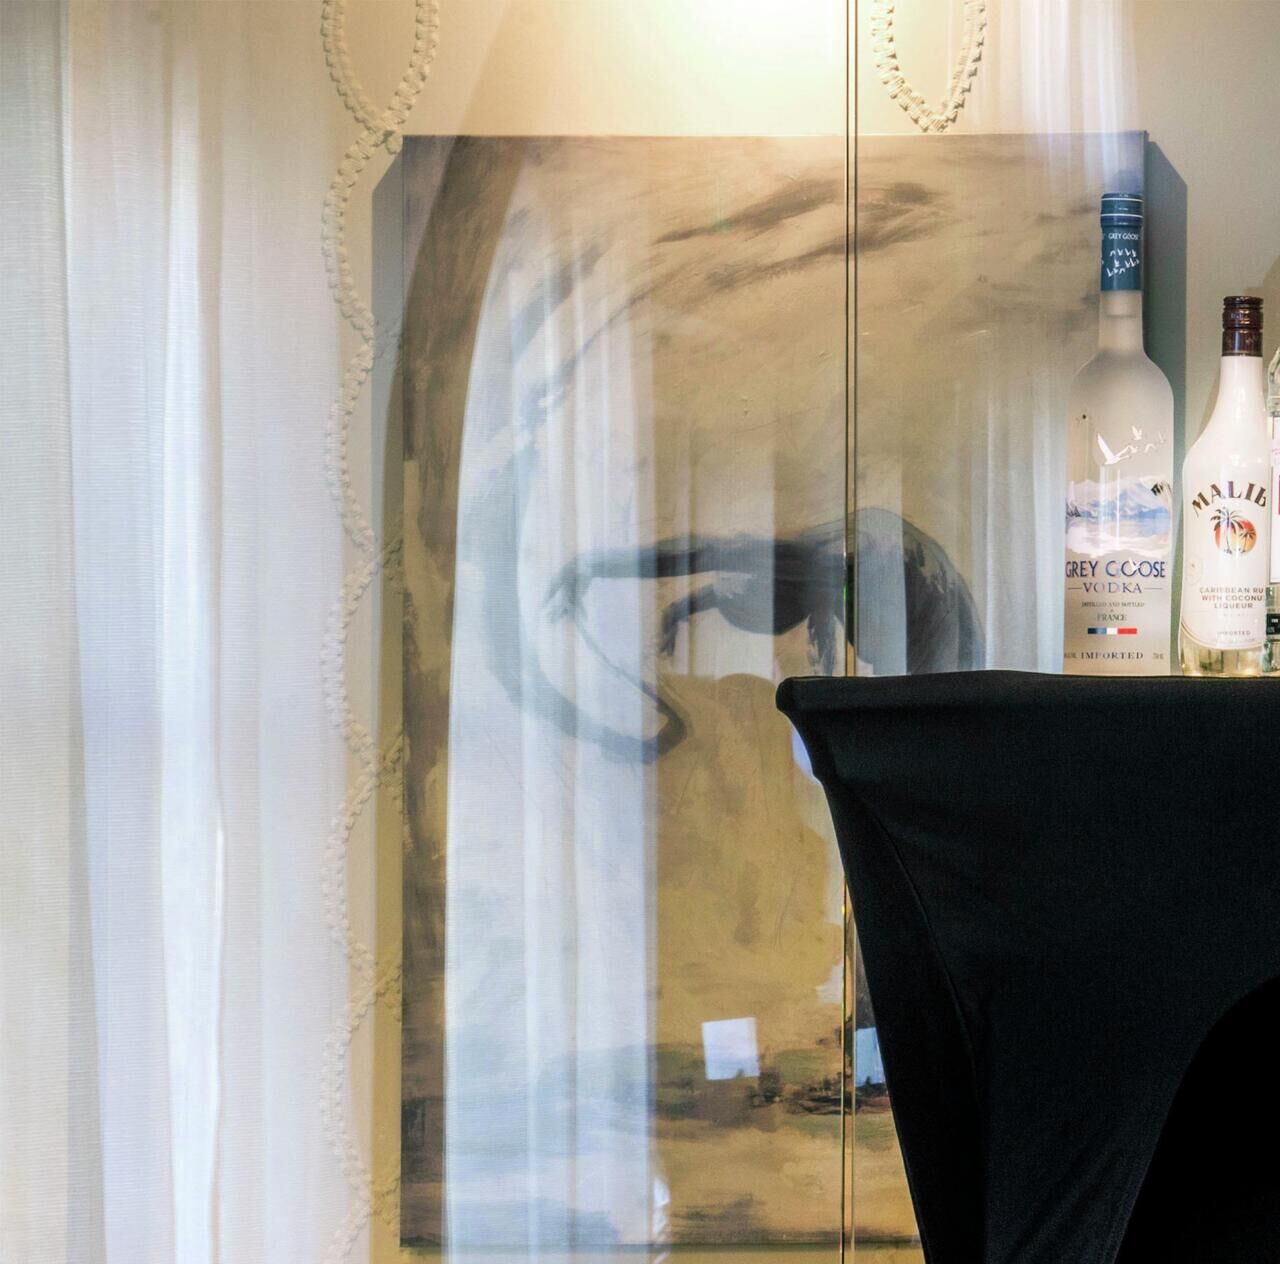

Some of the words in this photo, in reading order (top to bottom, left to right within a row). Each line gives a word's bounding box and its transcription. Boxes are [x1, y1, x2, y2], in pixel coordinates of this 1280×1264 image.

[1065, 560, 1098, 578] GREY
[1105, 560, 1166, 578] GOOSE
[1082, 582, 1143, 594] VODKA
[1096, 613, 1127, 622] FRANCE
[1081, 651, 1144, 660] IMPORTED
